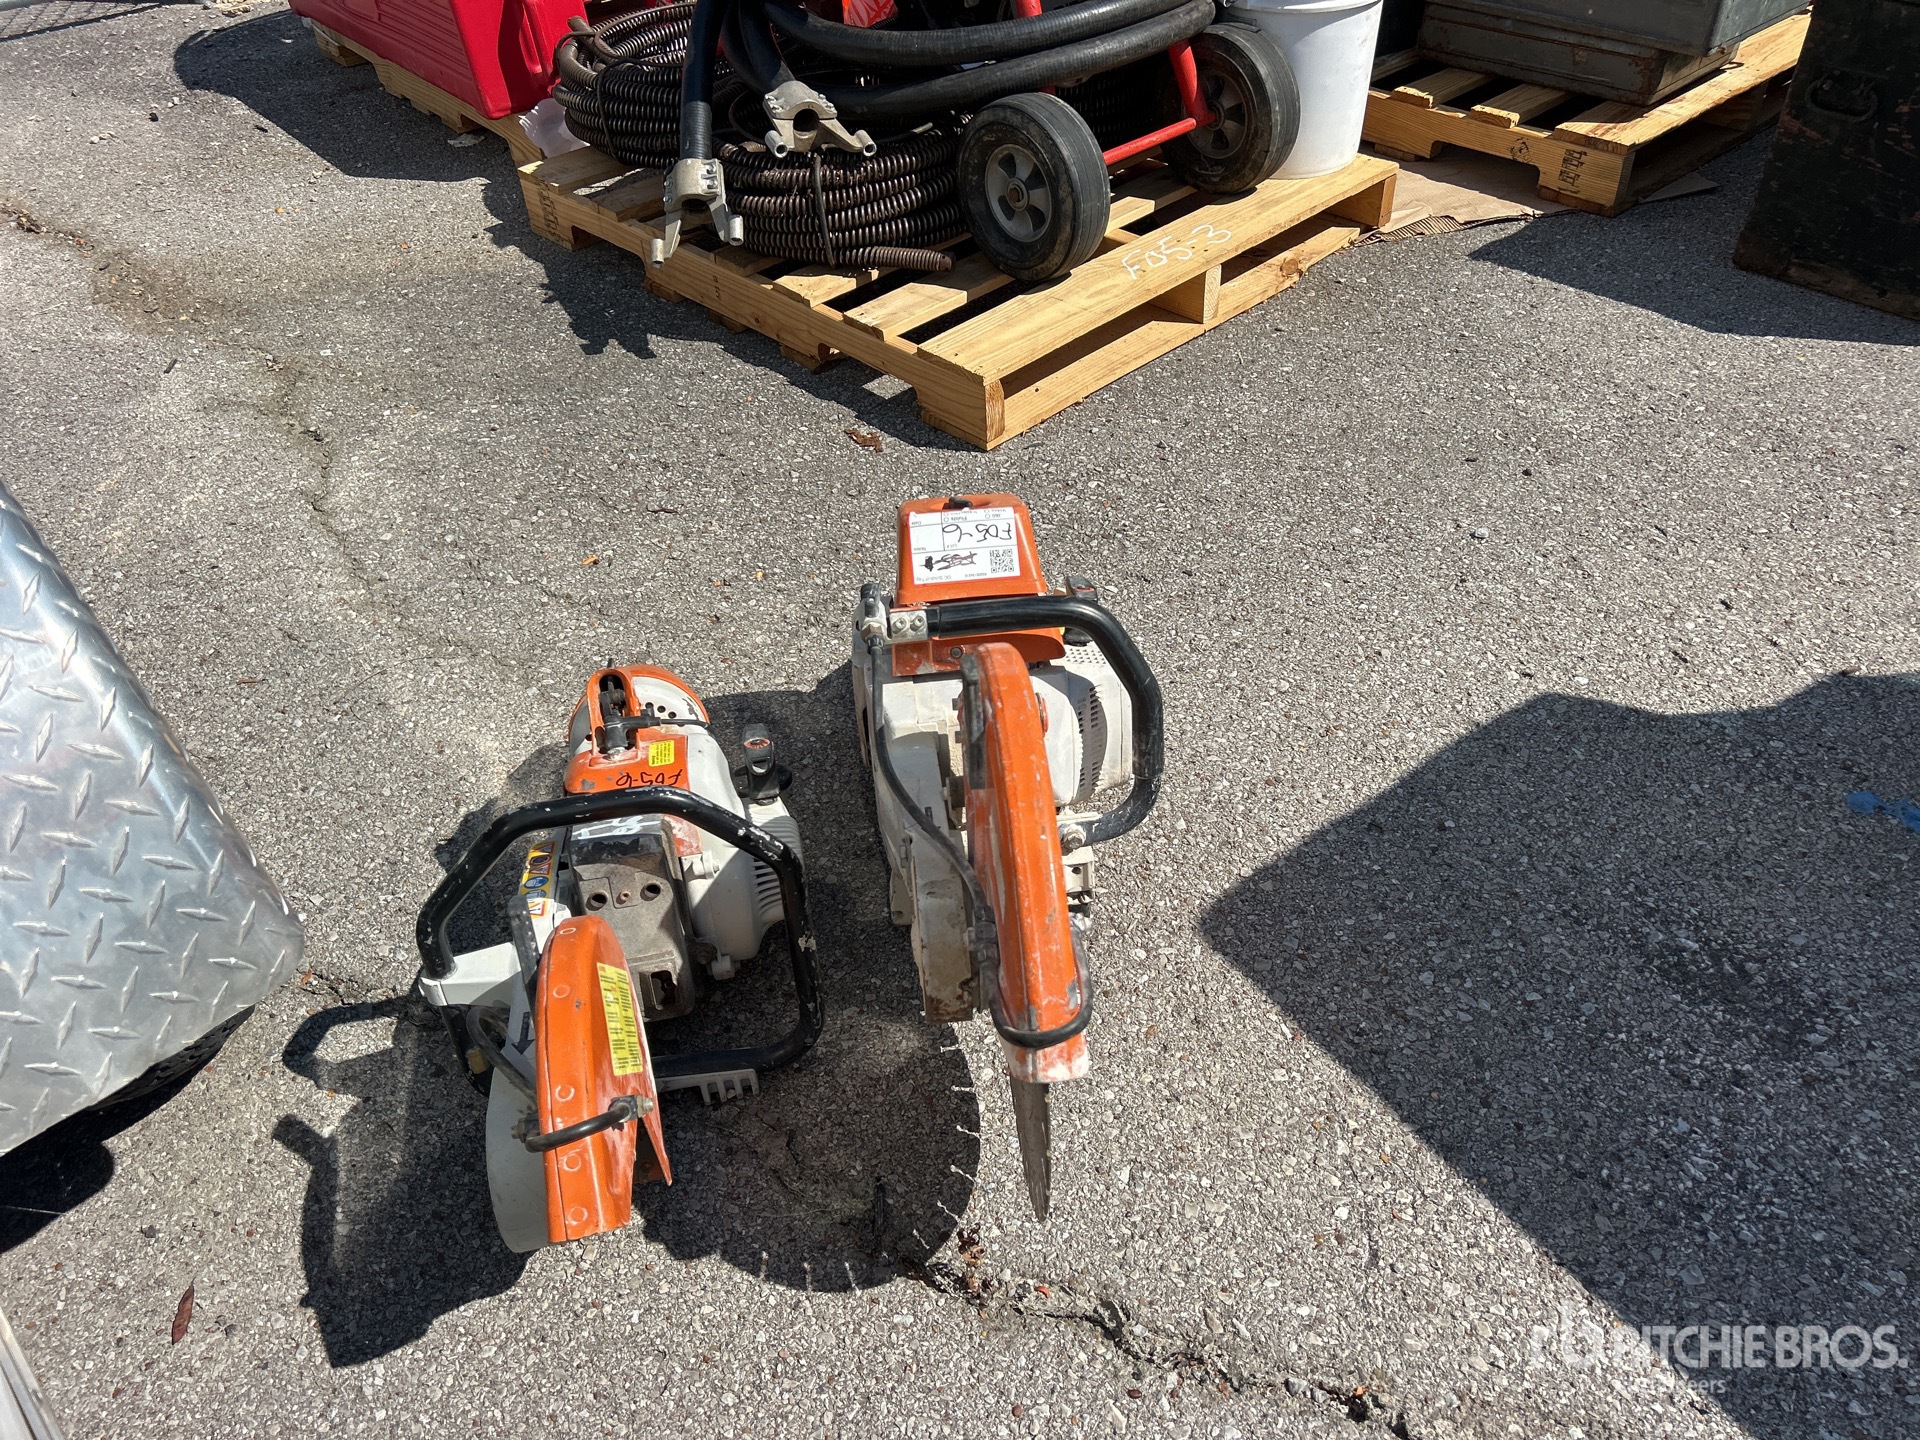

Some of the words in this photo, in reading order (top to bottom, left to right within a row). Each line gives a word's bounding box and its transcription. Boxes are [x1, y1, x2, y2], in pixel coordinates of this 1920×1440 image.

[1121, 224, 1232, 280] F05-3
[942, 522, 1012, 543] F05-6
[616, 769, 683, 787] F05-6
